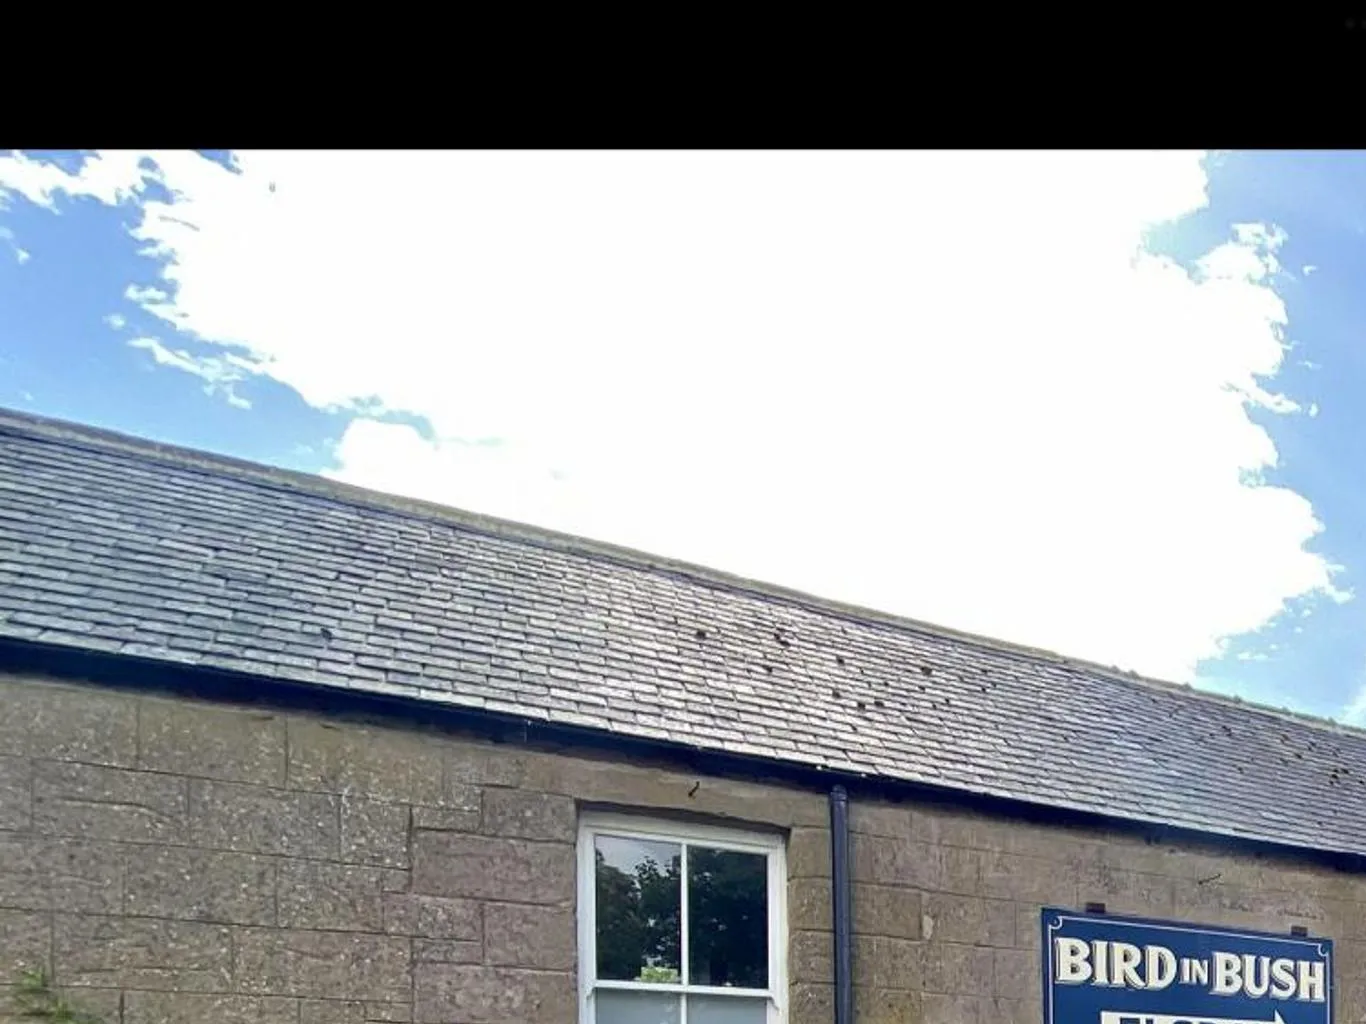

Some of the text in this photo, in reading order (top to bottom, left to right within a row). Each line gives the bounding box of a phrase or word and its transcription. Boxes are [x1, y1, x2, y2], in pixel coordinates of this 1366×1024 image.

[1054, 937, 1326, 1002] BIRD IN BUSH
